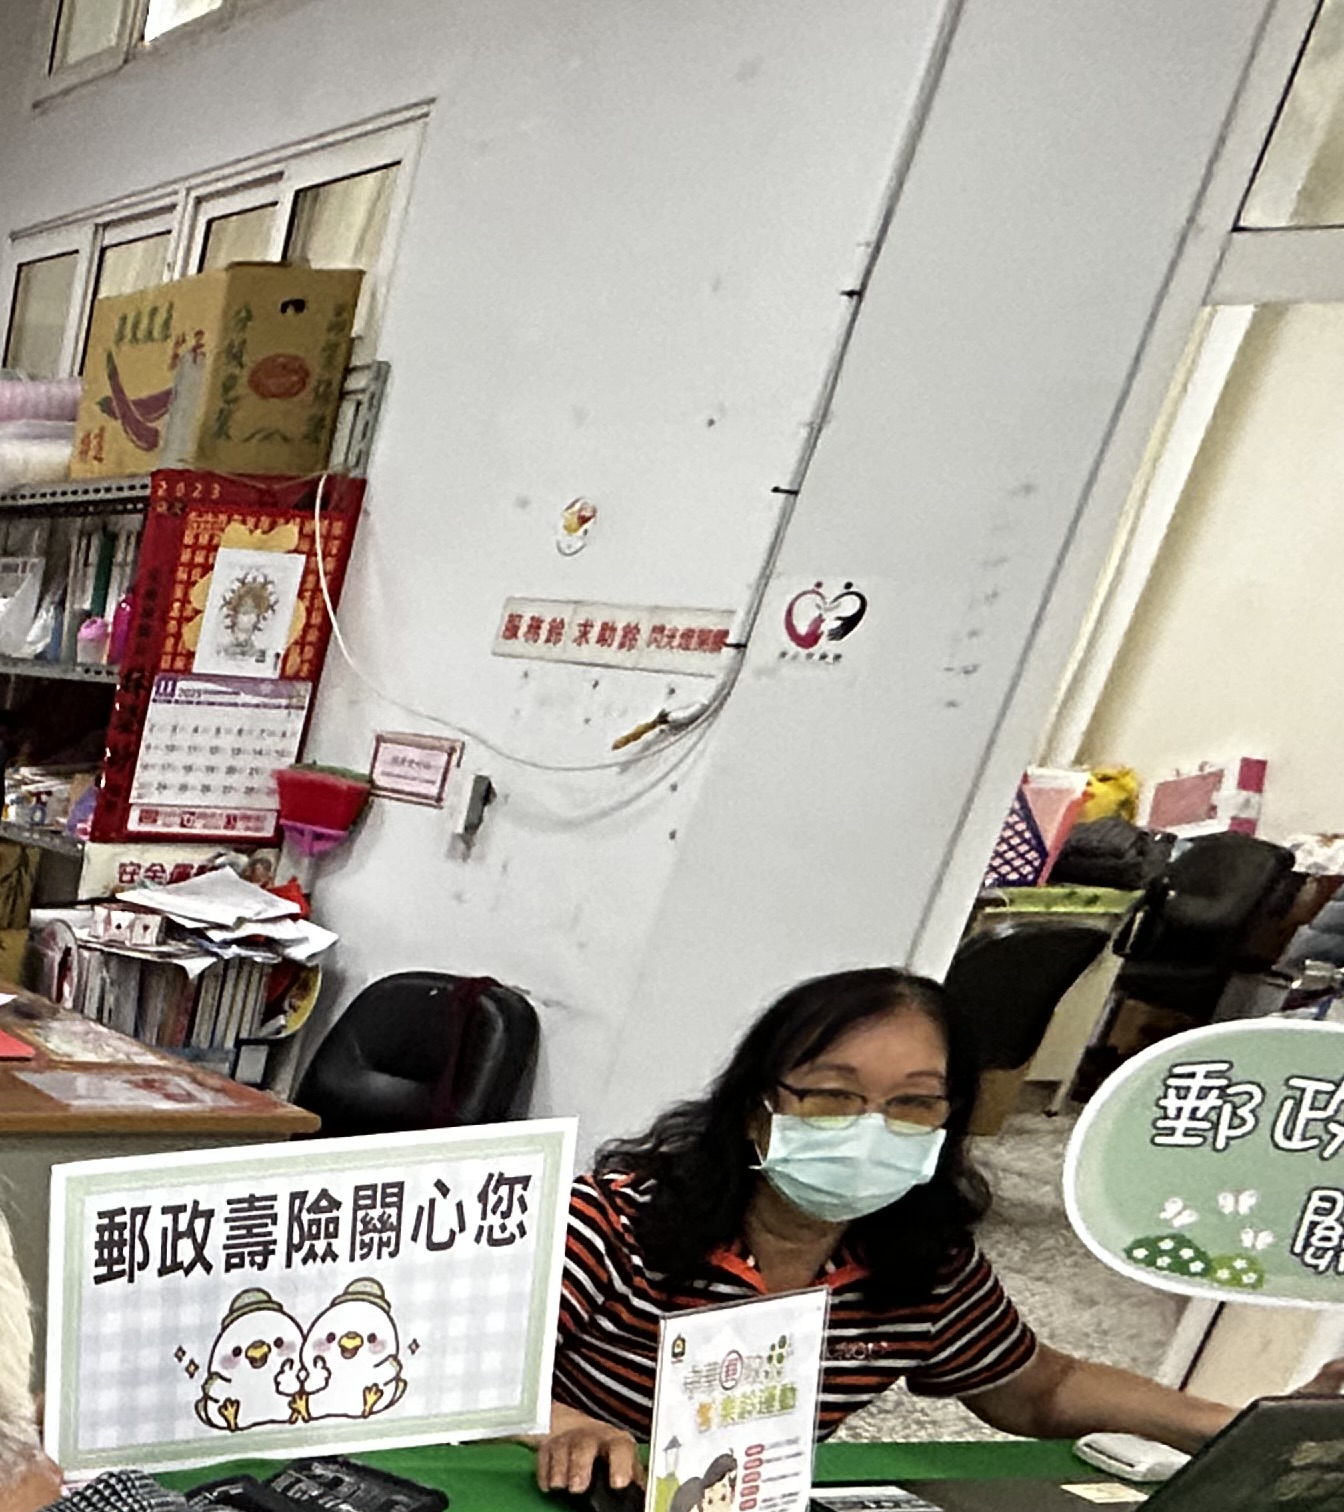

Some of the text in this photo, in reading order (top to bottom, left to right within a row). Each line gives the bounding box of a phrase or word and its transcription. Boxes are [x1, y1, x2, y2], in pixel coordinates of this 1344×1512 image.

[1151, 1060, 1344, 1162] 郵政
[92, 1171, 532, 1286] 郵政壽險關心您
